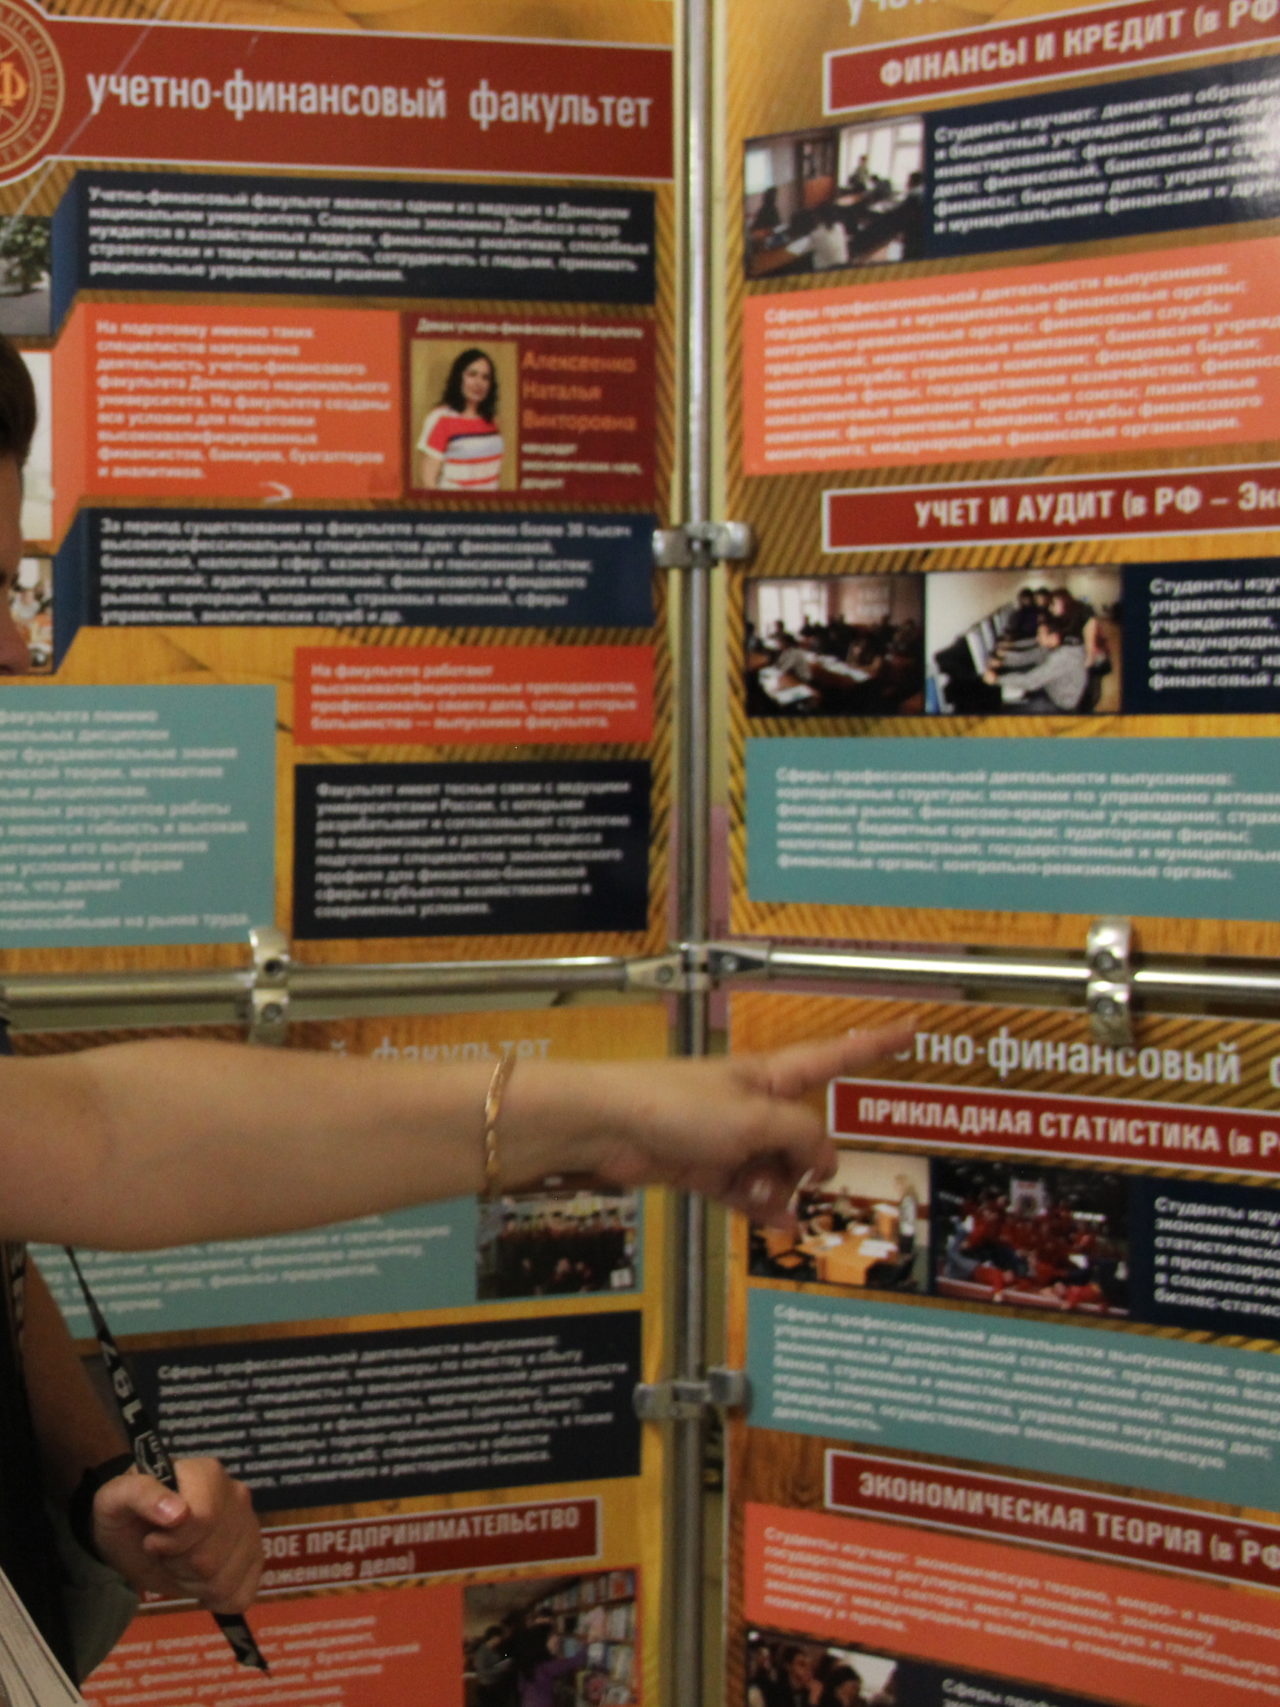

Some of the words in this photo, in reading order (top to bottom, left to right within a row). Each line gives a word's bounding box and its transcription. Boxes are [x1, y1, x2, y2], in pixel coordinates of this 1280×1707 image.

[879, 36, 1028, 87] ФИНАНСЫ
[1034, 31, 1056, 61] И
[1063, 8, 1186, 59] КРЕДИТ
[1193, 5, 1219, 38] (в
[1228, 0, 1279, 30] РФ
[86, 69, 447, 120] учетно-финансовый
[469, 79, 653, 132] факультет
[934, 120, 1016, 141] Студенты
[1103, 95, 1191, 120] денежное
[934, 150, 946, 161] и
[948, 136, 1047, 159] бюджетных
[1082, 130, 1201, 162] финансовый
[1105, 147, 1211, 174] банковский
[1215, 149, 1229, 160] и
[1021, 184, 1105, 205] биржевое
[934, 222, 946, 233] и
[948, 205, 1100, 234] муниципальными
[1106, 192, 1209, 217] финансами
[1216, 190, 1225, 201] и
[522, 380, 603, 401] Наталья
[522, 409, 637, 434] Викторовна
[914, 498, 983, 528] УЧЕТ
[989, 496, 1009, 524] И
[1016, 489, 1116, 526] АУДИТ
[1123, 489, 1147, 520] (в
[1154, 485, 1202, 516] РФ
[1150, 577, 1240, 595] Студенты
[1149, 671, 1269, 691] финансовый
[894, 1026, 1242, 1085] тно-финансовый
[858, 1097, 1033, 1136] ПРИКЛАДНАЯ
[1039, 1112, 1220, 1152] СТАТИСТИКА
[1228, 1128, 1252, 1156] (в
[1155, 1198, 1243, 1220] Студенты
[1154, 1255, 1167, 1267] и
[1154, 1273, 1167, 1285] в
[306, 1506, 580, 1555] ПРЕДПРИНИМАТЕЛЬСТВО
[858, 1471, 1086, 1534] ЭКОНОМИЧЕСКАЯ
[1093, 1510, 1203, 1556] ТЕОРИЯ
[1210, 1535, 1233, 1561] (в
